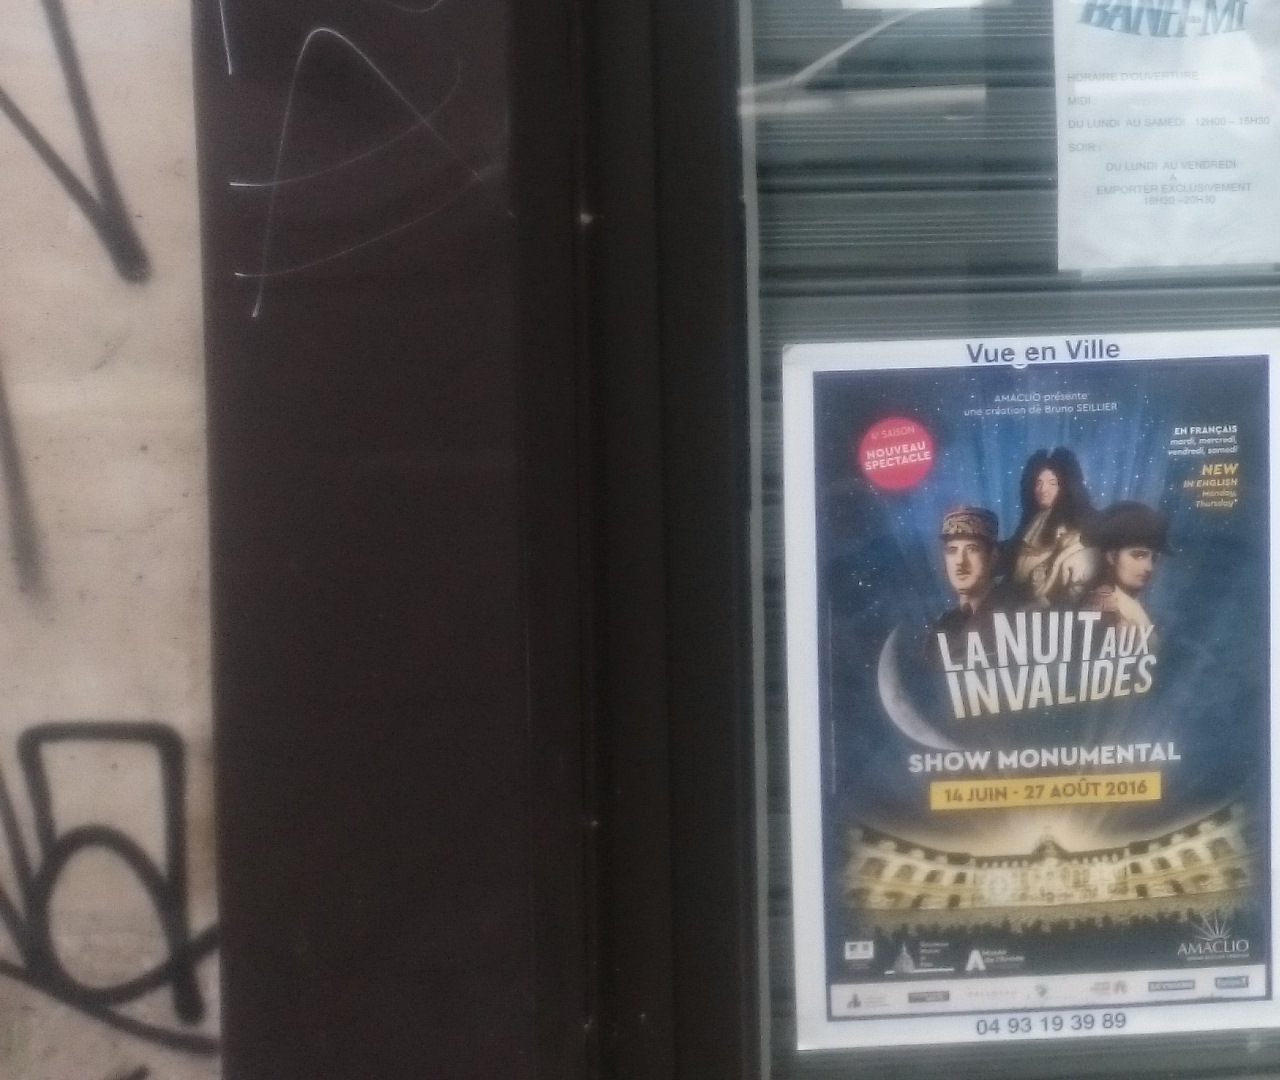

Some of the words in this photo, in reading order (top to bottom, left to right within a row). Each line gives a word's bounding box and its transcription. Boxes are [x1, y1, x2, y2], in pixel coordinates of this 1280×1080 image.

[1066, 72, 1119, 83] HORAIRE
[1068, 119, 1084, 129] DU
[1087, 119, 1121, 129] LUNDI
[1125, 119, 1141, 128] AU
[1144, 117, 1185, 128] SAMEDI
[1068, 142, 1096, 153] SOIR
[1105, 161, 1122, 172] DU
[1124, 161, 1159, 171] LUNDI
[1163, 161, 1178, 170] AU
[1179, 160, 1237, 170] VENDREDI
[1096, 184, 1159, 195] EMPORTER
[1160, 182, 1253, 194] EXCLUSIVEMENT
[965, 343, 1016, 363] Vue
[1025, 346, 1056, 361] en
[1065, 338, 1121, 360] Ville
[994, 393, 1041, 402] AMACLIO
[1043, 391, 1088, 402] présente
[963, 408, 983, 416] une
[985, 405, 1026, 416] création
[1029, 404, 1042, 414] de
[1044, 404, 1074, 414] Bruno
[1076, 402, 1118, 413] SEILLIER
[881, 425, 916, 439] SAISON
[1174, 427, 1188, 435] EN
[1190, 424, 1238, 435] FRANÇAIS
[1169, 436, 1197, 446] mardi,
[866, 440, 927, 460] NOUVEAU
[1207, 444, 1238, 454] samedi
[864, 450, 932, 471] SPECTACLE
[1201, 462, 1239, 476] NEW
[1183, 480, 1194, 489] IN
[1196, 478, 1238, 488] ENGLISH
[937, 630, 991, 672] LA
[992, 611, 1102, 668] NUIT
[1100, 623, 1155, 659] AUX
[946, 654, 1158, 719] INVALIDES
[908, 750, 992, 773] SHOW
[998, 741, 1182, 769] MONUMENTAL
[945, 788, 963, 802] 14
[967, 786, 1008, 802] JUIN
[1023, 784, 1046, 799] 27
[1050, 777, 1102, 798] AOÛT
[1105, 780, 1148, 796] 2016
[1177, 939, 1250, 956] AMACLIO
[976, 1019, 1001, 1035] 04
[1007, 1017, 1033, 1034] 93
[1040, 1015, 1064, 1032] 19
[1070, 1014, 1096, 1031] 39
[1101, 1012, 1127, 1029] 89
